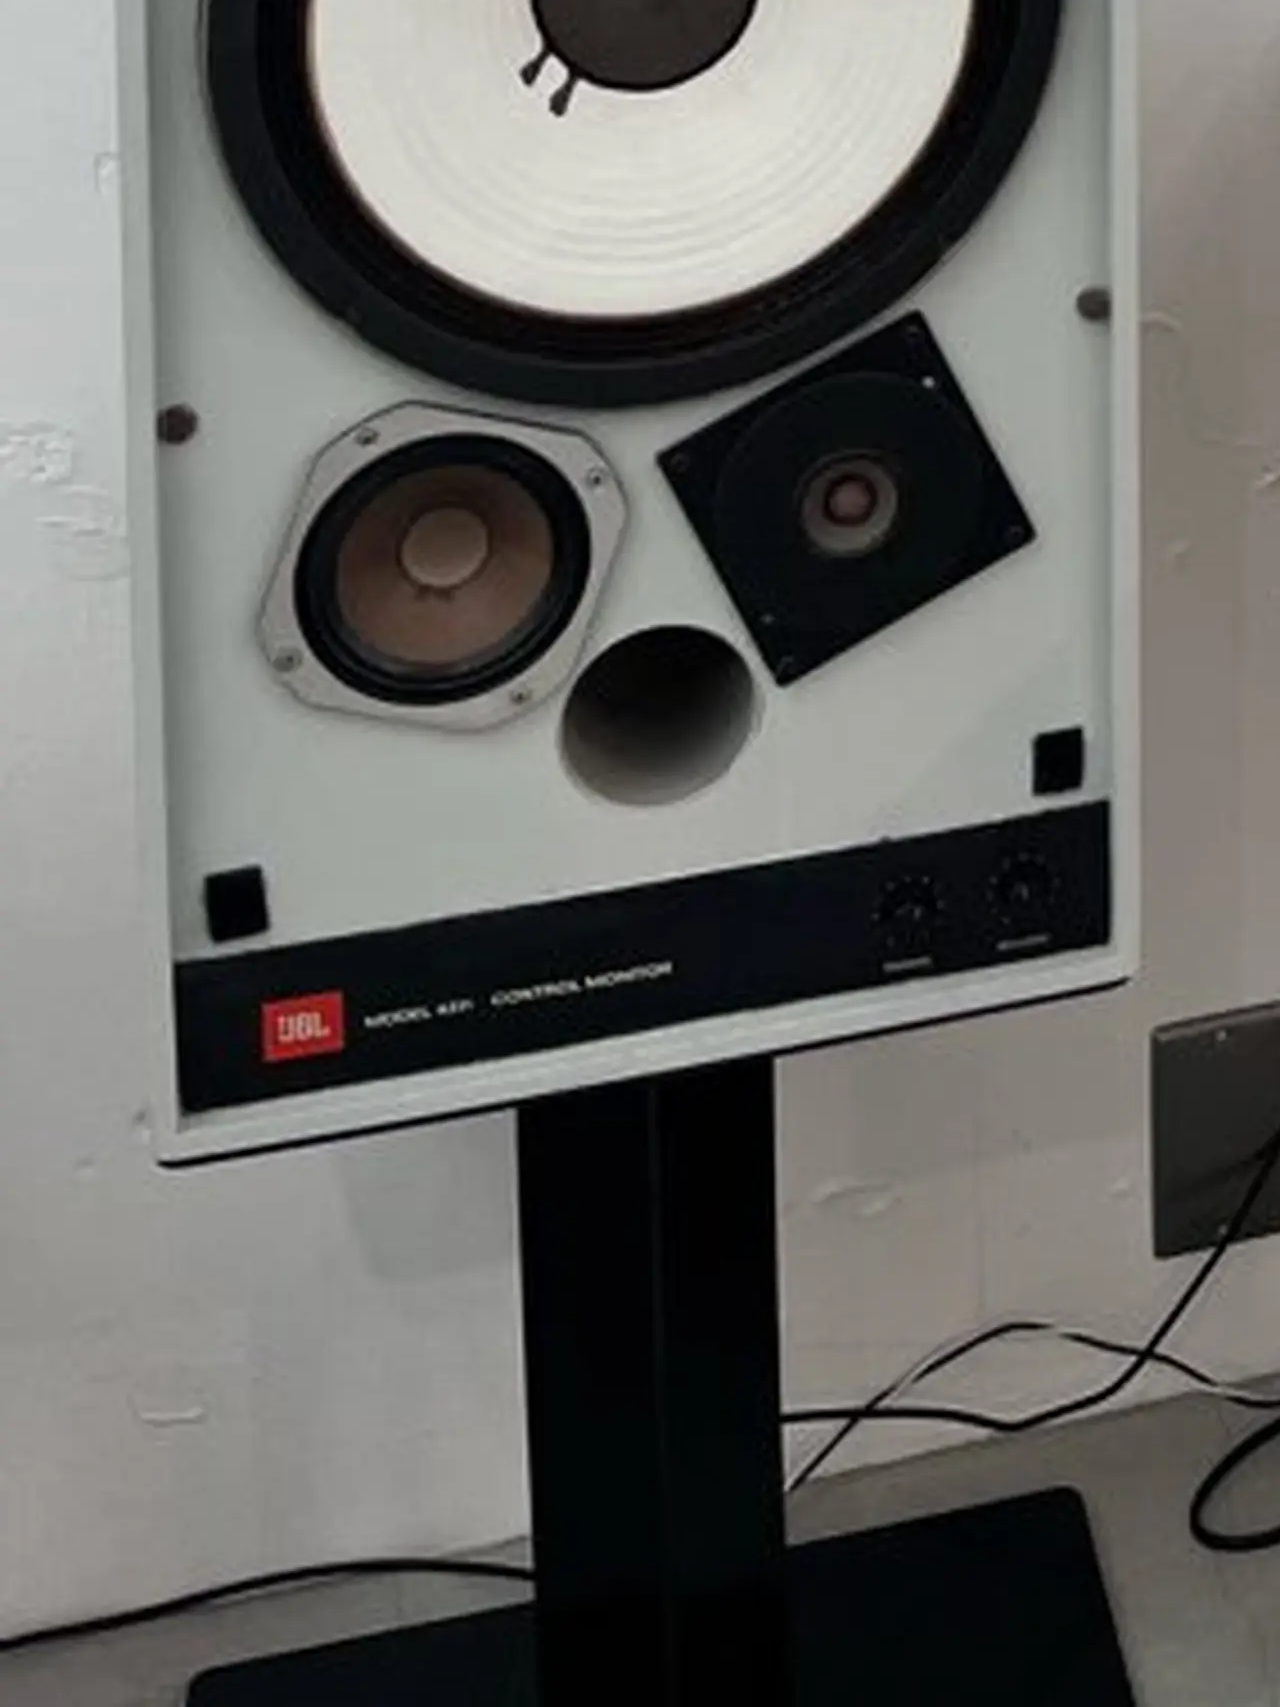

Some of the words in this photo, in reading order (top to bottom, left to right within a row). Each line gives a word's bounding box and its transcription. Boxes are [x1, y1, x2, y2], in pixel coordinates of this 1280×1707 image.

[364, 1006, 431, 1028] MODEL
[490, 980, 581, 1005] CONTROL
[584, 960, 672, 988] MONITOR
[277, 1010, 331, 1043] JBL
